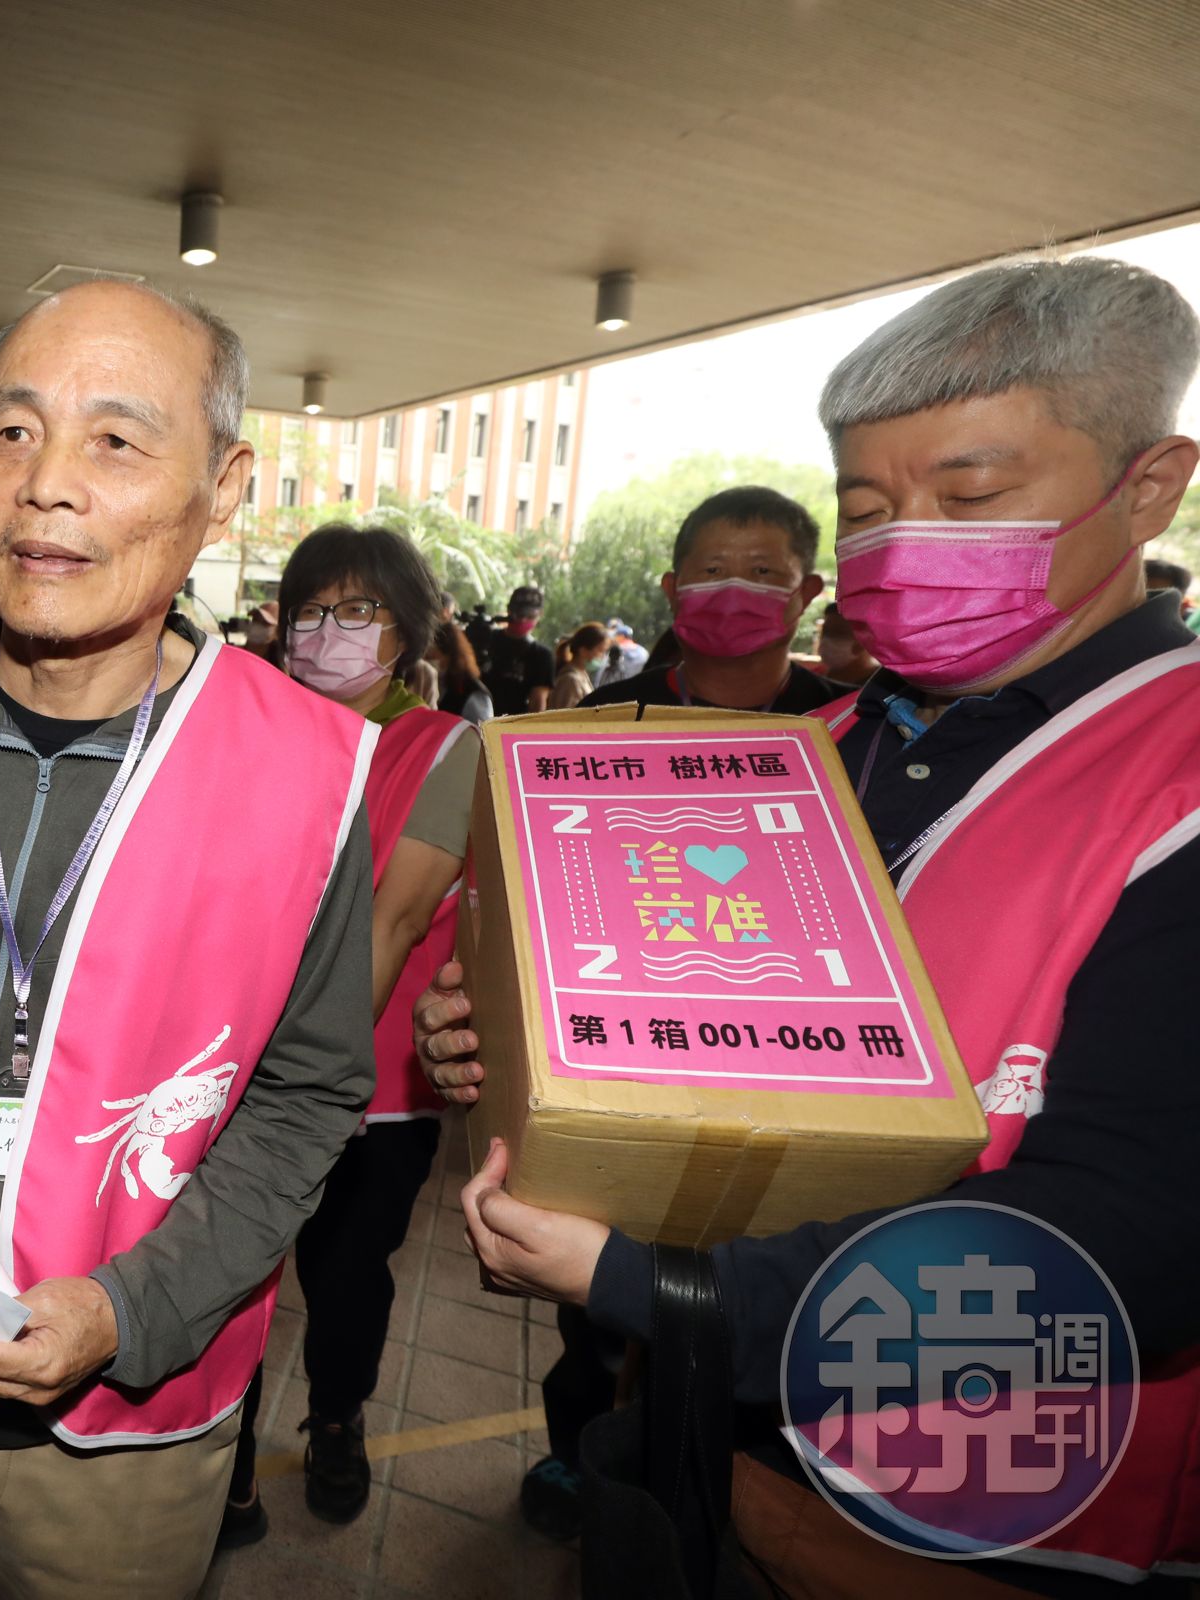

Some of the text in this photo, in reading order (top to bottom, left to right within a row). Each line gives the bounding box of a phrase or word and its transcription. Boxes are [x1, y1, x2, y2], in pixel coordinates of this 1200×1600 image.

[536, 753, 789, 780] 新北市 樹林區
[550, 803, 804, 834] 2 0
[574, 944, 850, 986] 2 1
[570, 1015, 904, 1057] 第 1 箱 001-060 冊
